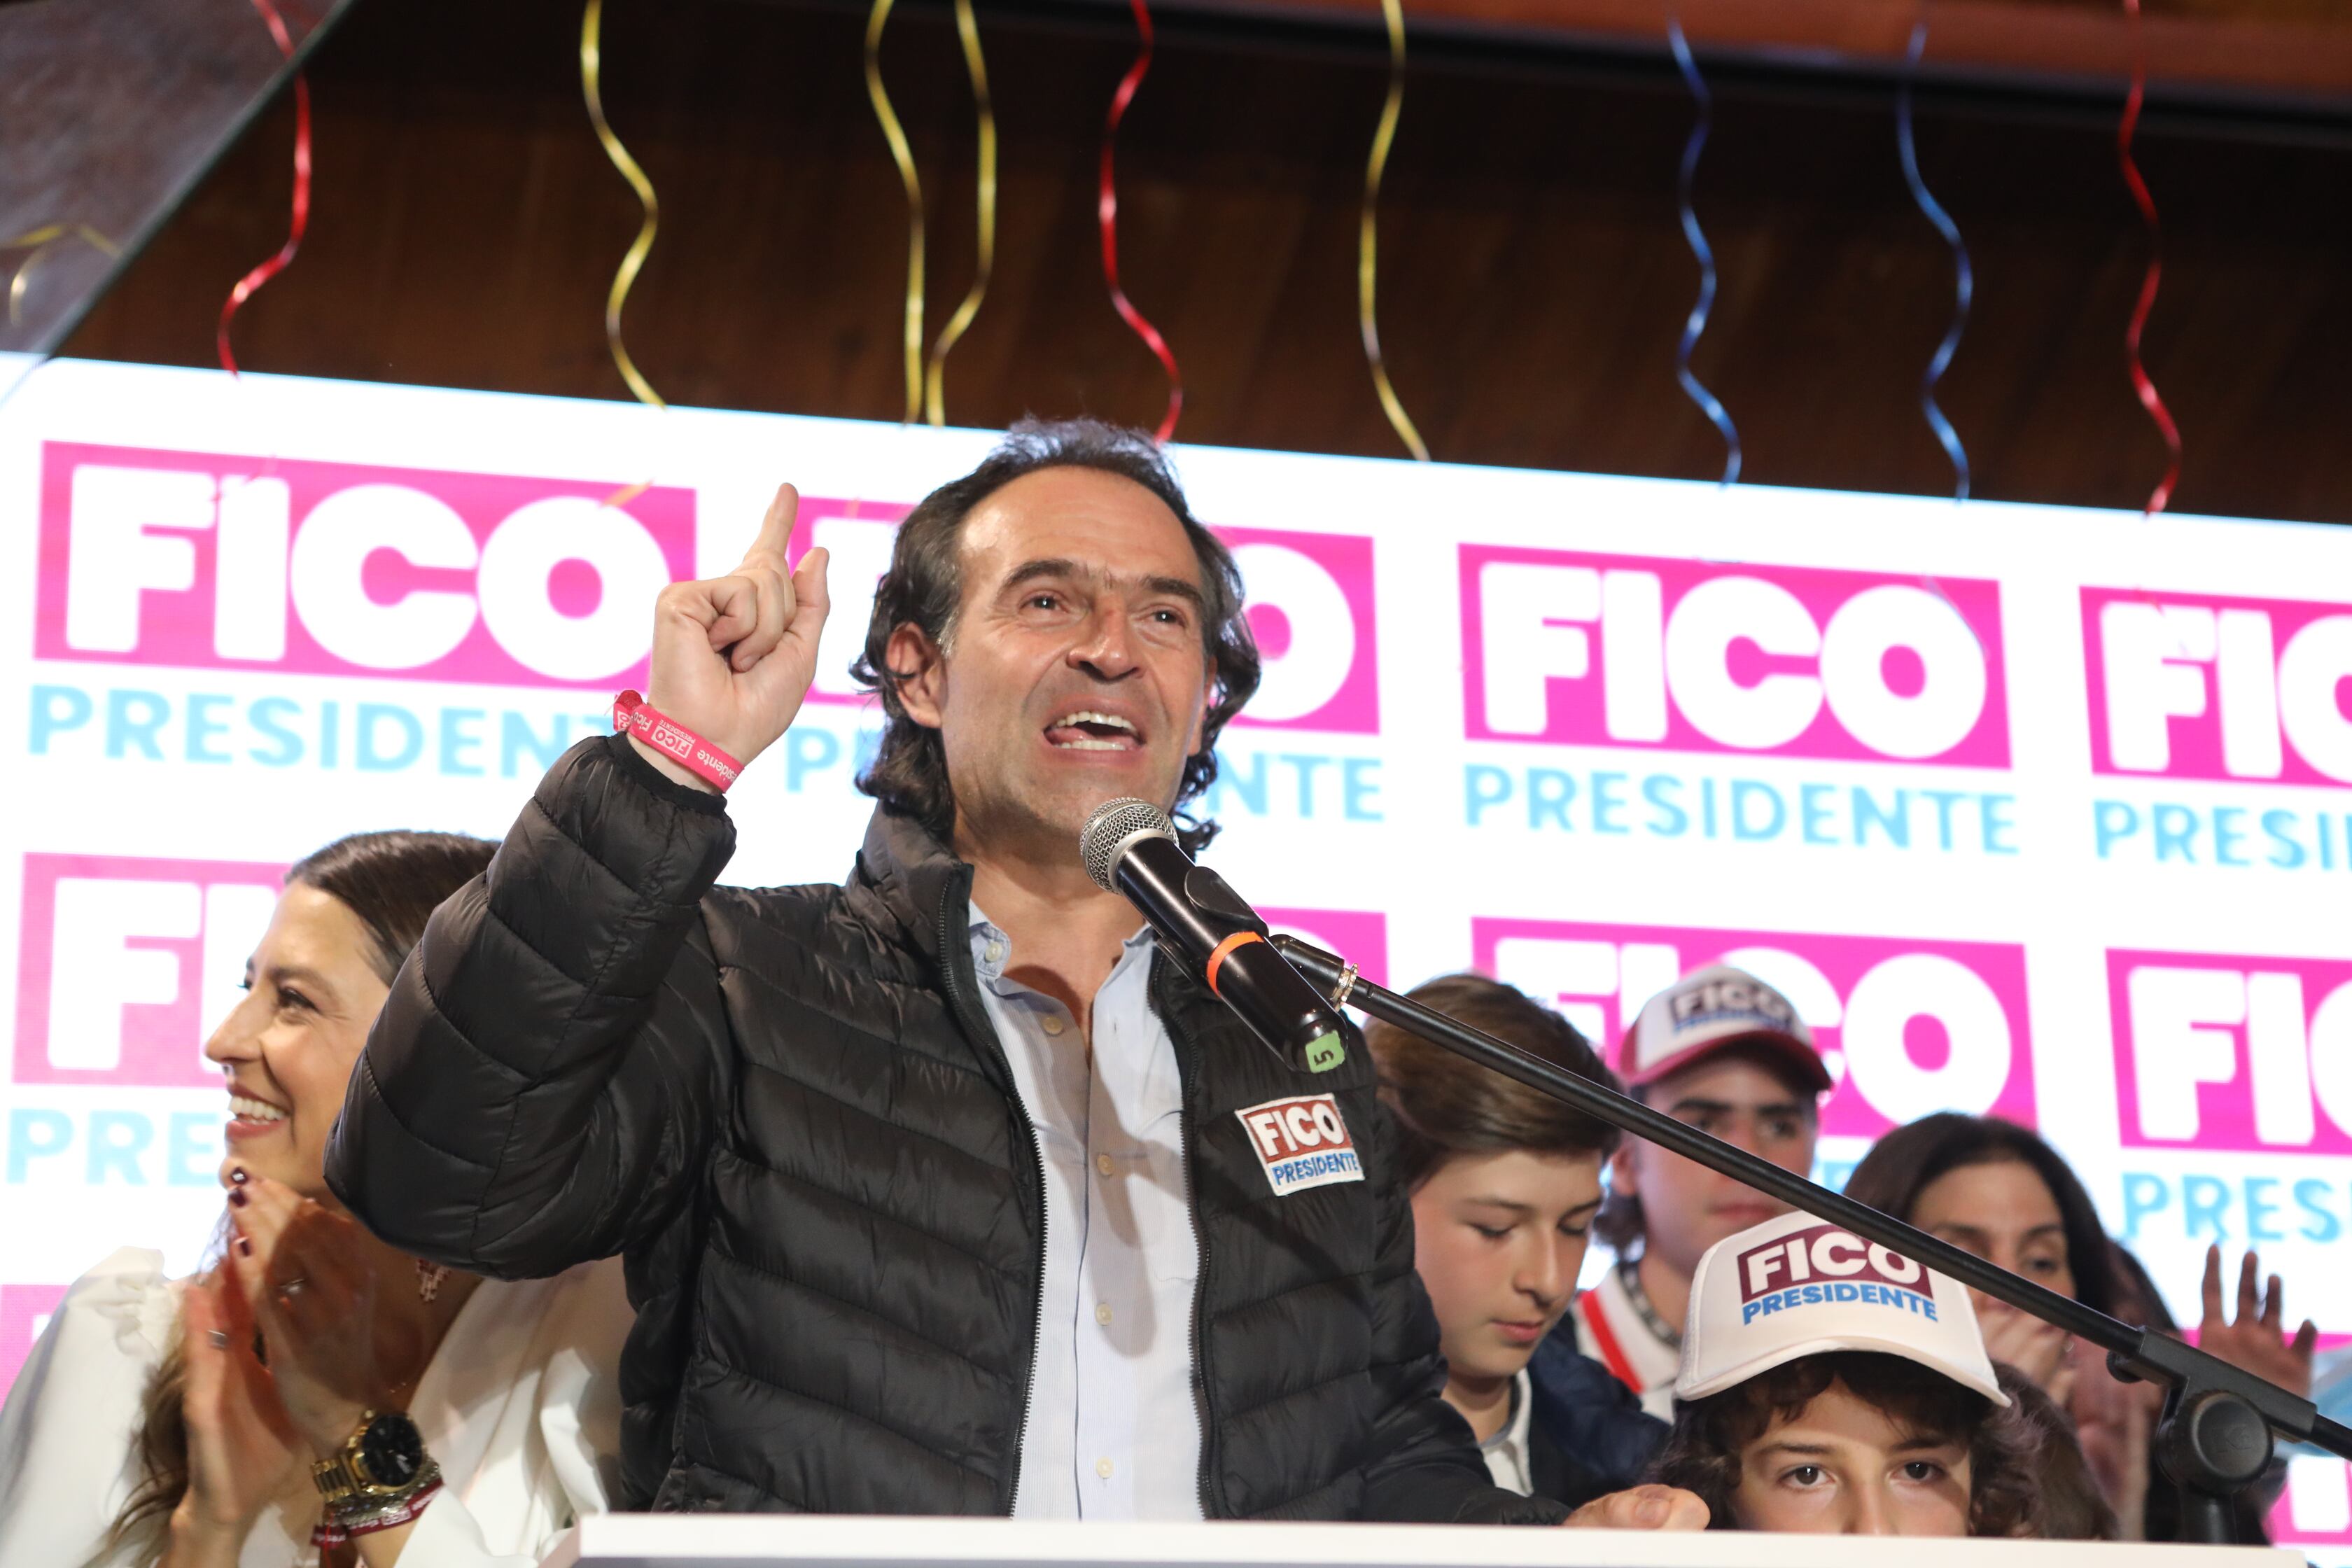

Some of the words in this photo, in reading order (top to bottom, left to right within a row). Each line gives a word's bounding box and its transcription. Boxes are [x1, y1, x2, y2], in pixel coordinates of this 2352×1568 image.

[66, 463, 670, 681] FICO
[1478, 561, 1988, 760] FICO
[632, 711, 653, 732] Fico
[655, 730, 690, 755] FICO
[659, 719, 696, 744] PRESIDENTE
[1463, 763, 2022, 856] PRESIDENTE
[2092, 798, 2352, 873] PRESI
[1313, 1049, 1334, 1066] 5
[2127, 965, 2352, 1147] FI
[1247, 1102, 1345, 1157] FICO
[1746, 1231, 1921, 1296] FICO
[1742, 1283, 1938, 1326] PRESIDENTE
